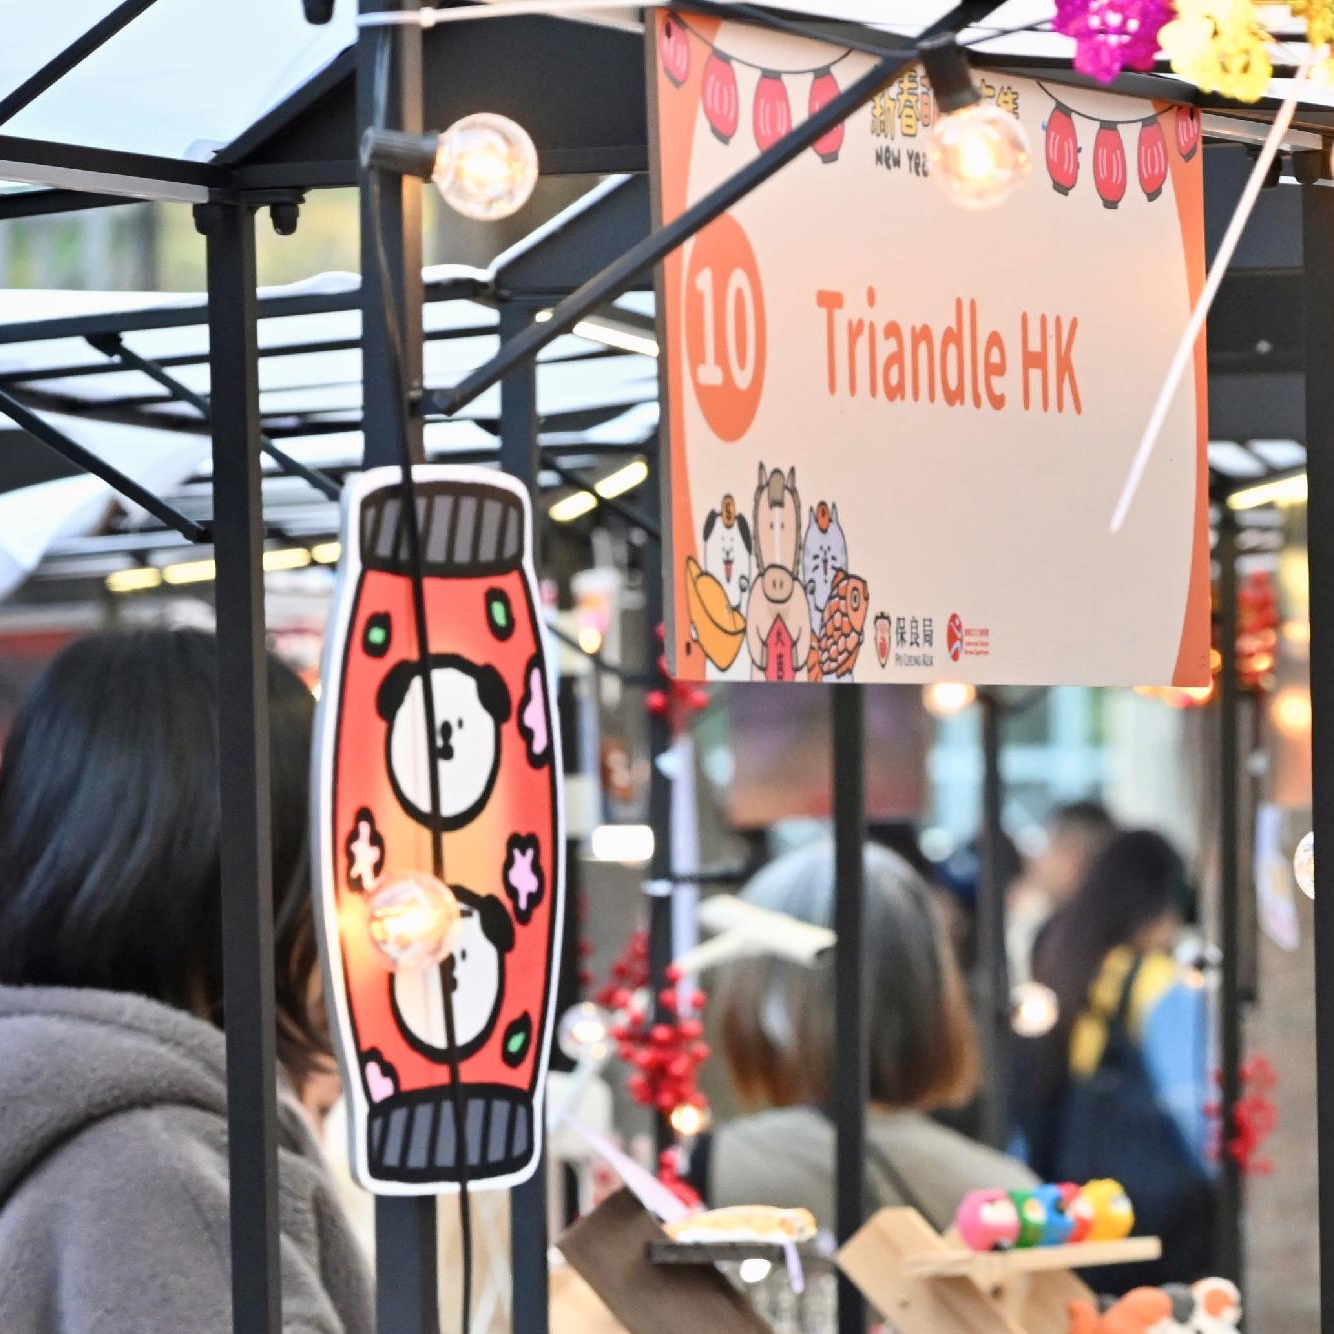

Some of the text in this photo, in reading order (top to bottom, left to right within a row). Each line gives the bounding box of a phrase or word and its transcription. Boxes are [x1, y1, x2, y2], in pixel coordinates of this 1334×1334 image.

[695, 267, 756, 390] 10
[816, 286, 1083, 416] Triandle HK
[895, 616, 934, 647] 保良局
